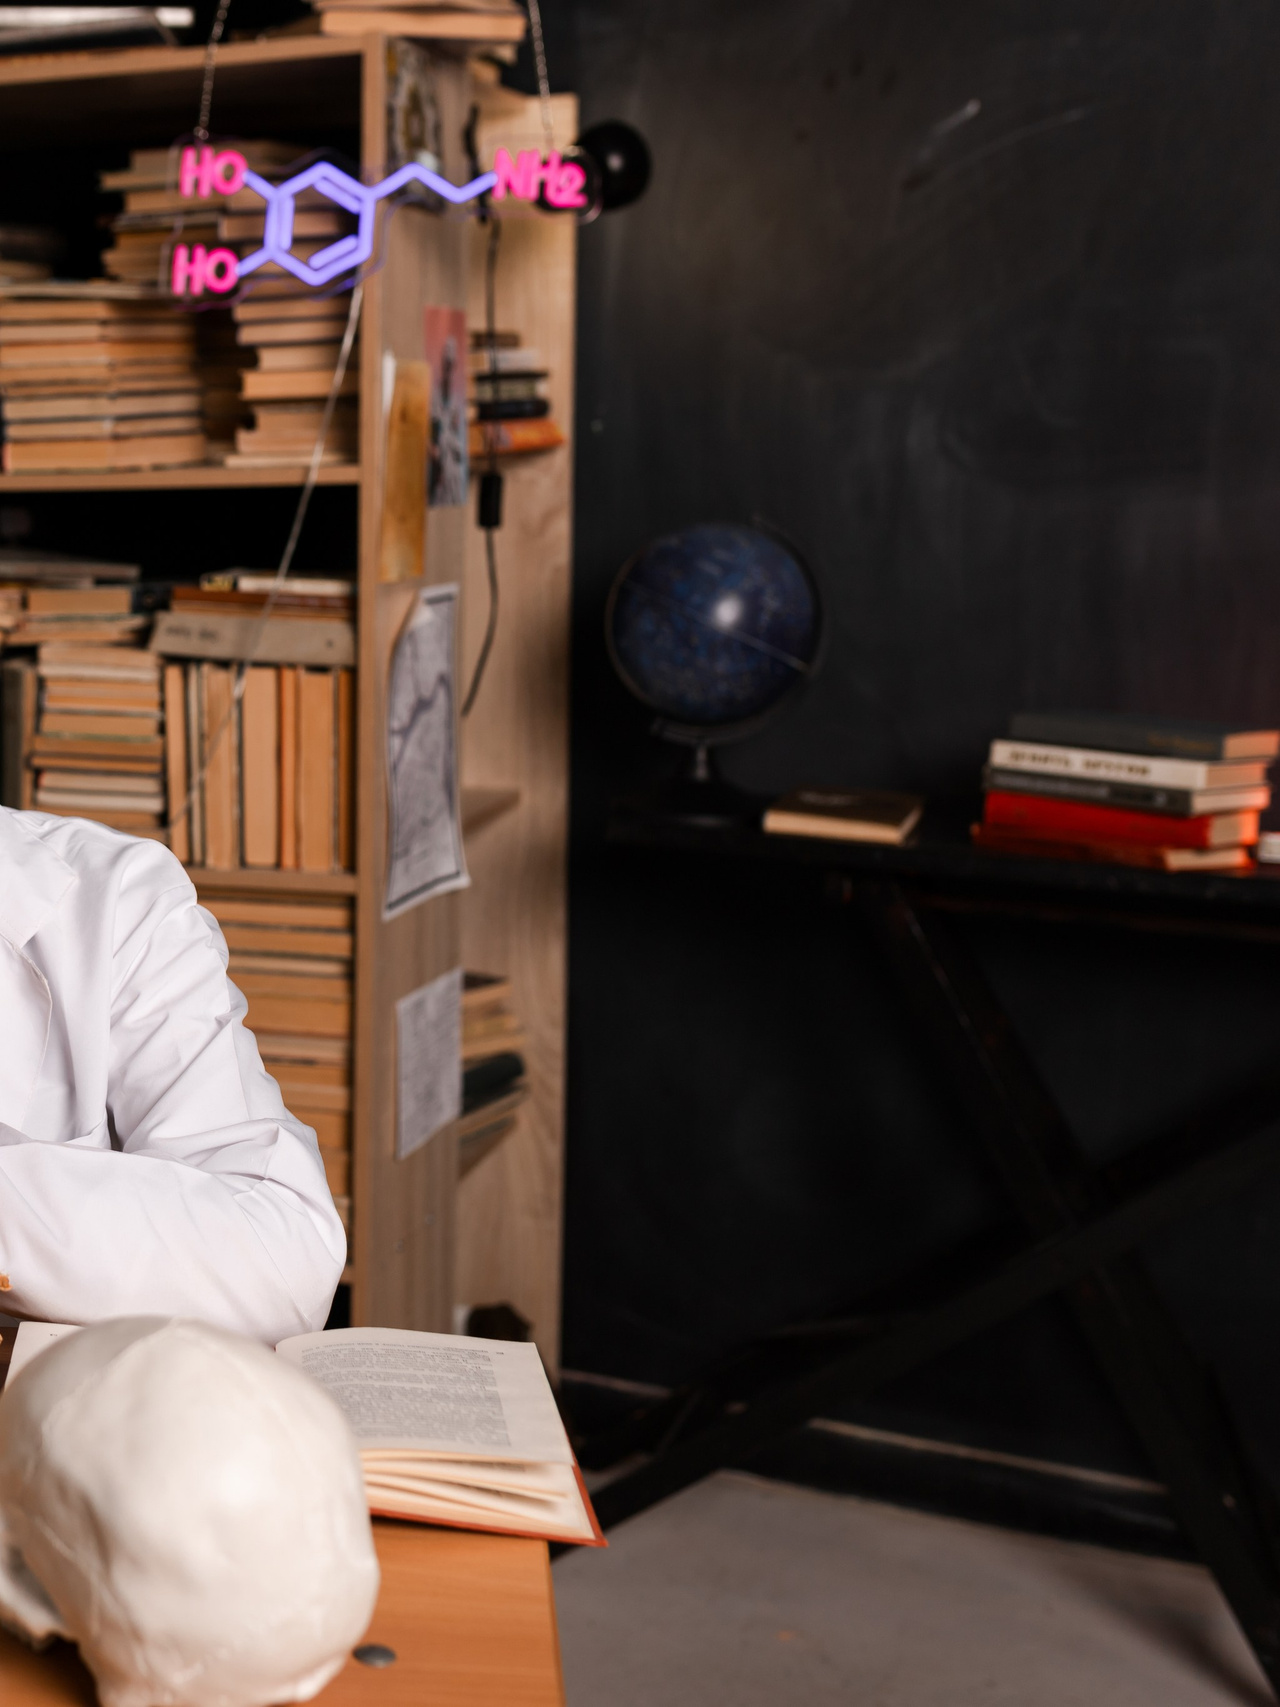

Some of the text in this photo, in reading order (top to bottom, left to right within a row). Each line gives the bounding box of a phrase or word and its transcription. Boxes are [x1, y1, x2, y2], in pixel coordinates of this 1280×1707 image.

[179, 145, 248, 199] HO
[491, 147, 588, 210] NH2
[172, 242, 240, 297] HO
